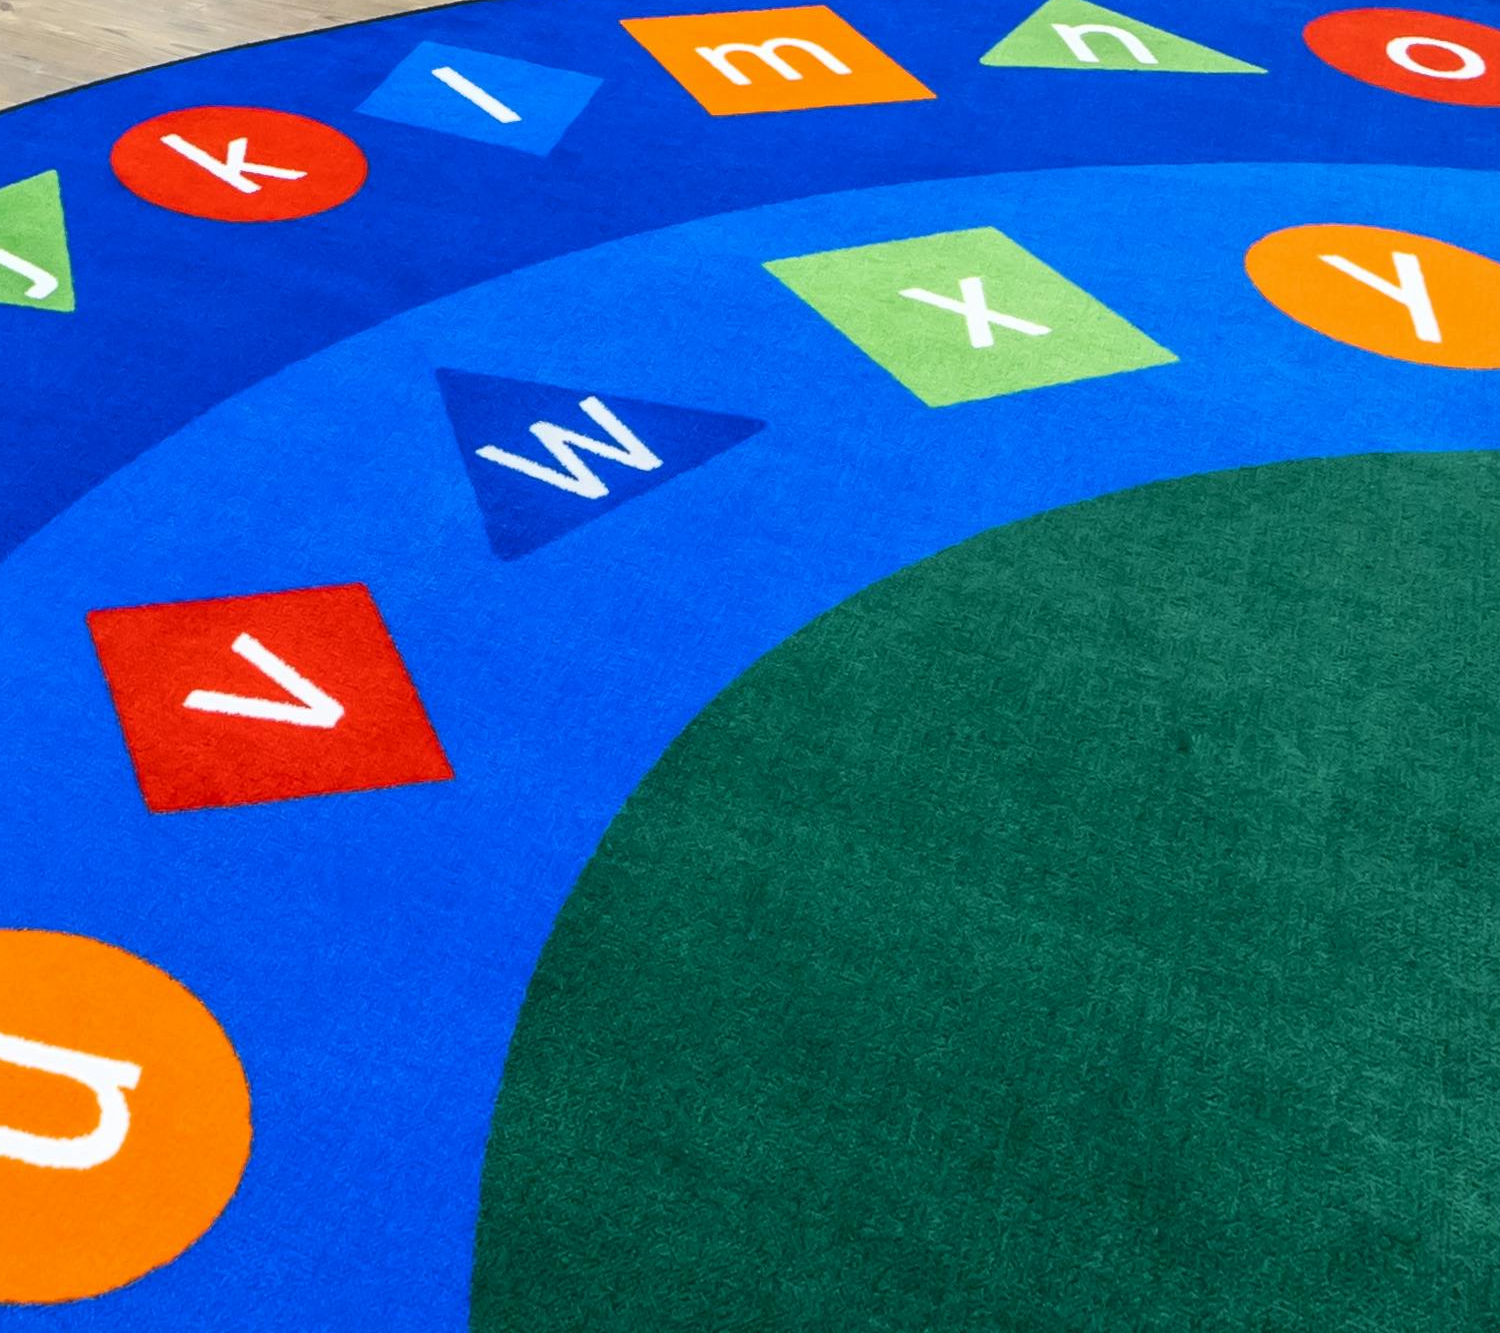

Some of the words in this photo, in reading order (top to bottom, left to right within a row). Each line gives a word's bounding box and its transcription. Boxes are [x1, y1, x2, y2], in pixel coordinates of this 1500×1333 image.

[161, 135, 307, 193] k
[432, 67, 520, 123] l
[696, 38, 851, 85] m
[1049, 22, 1161, 66] n
[1387, 37, 1485, 79] o
[184, 633, 344, 728] v
[477, 397, 661, 498] w
[898, 275, 1053, 350] x
[1321, 252, 1441, 343] y
